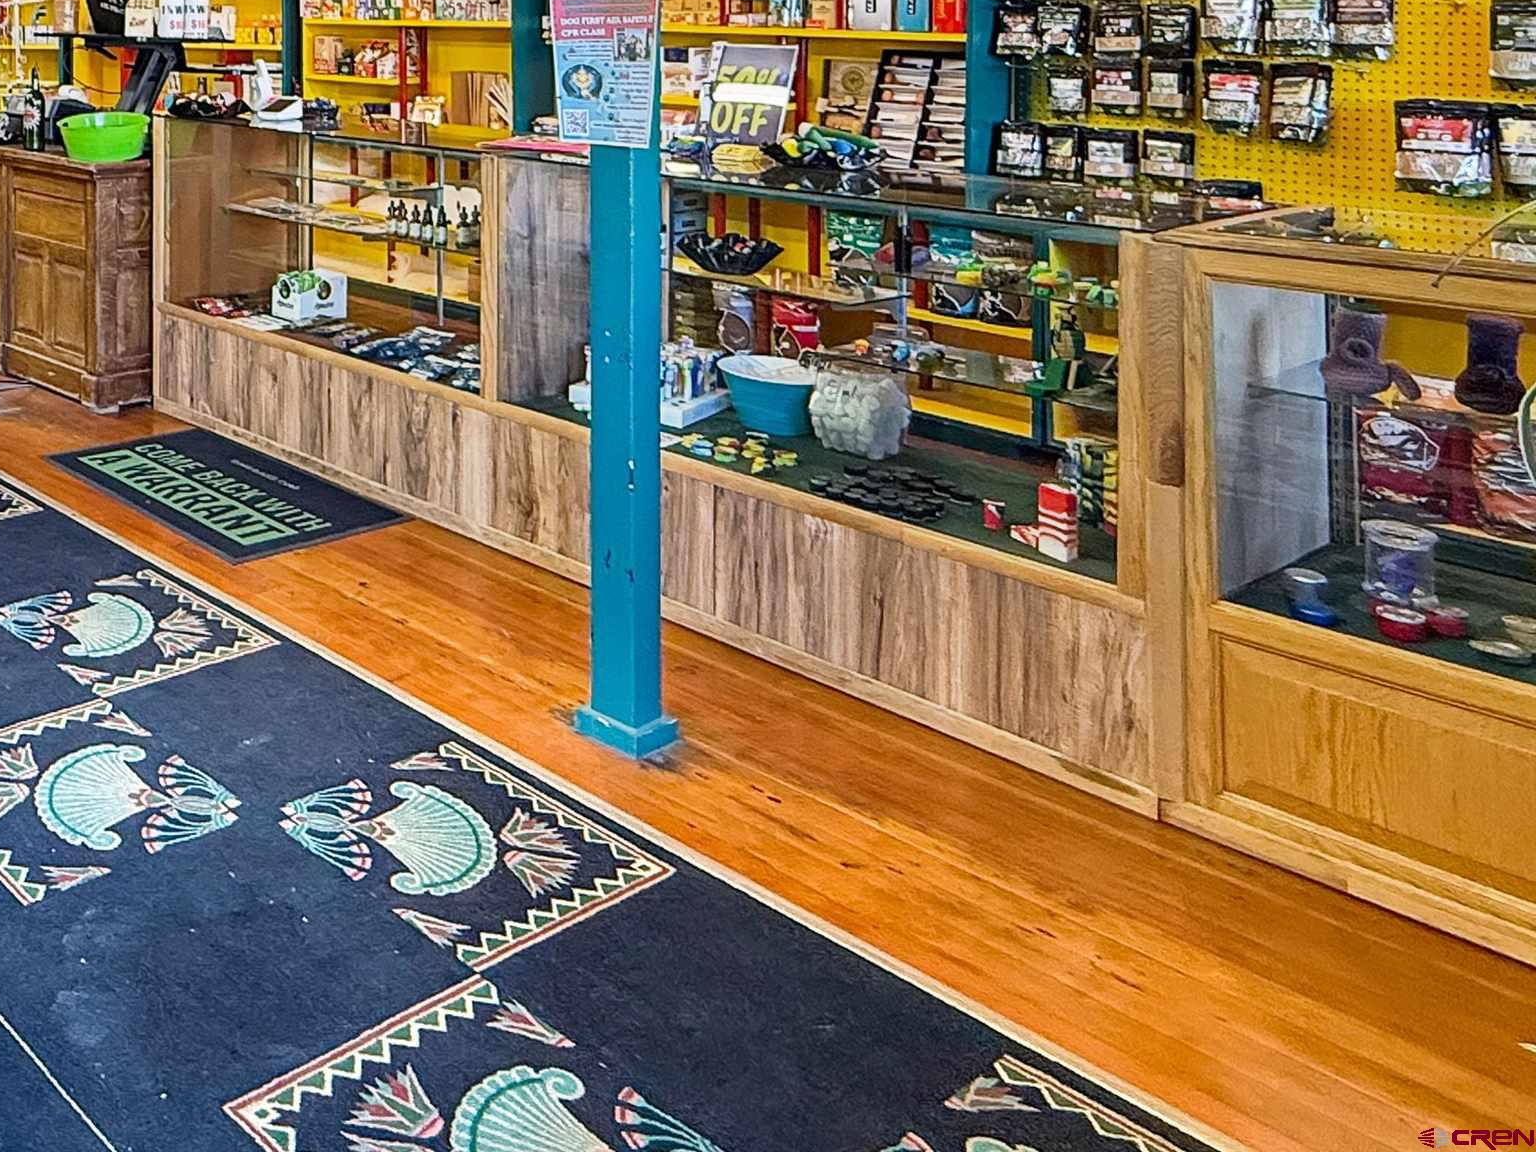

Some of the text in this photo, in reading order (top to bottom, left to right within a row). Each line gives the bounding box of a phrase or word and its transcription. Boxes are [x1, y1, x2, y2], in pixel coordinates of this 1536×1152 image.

[560, 17, 580, 25] DOG
[581, 16, 605, 25] FIRST
[560, 28, 606, 37] CPR CLASS
[711, 101, 771, 136] OFF
[88, 454, 132, 468] A
[115, 462, 285, 541] WARRANT
[135, 443, 207, 474] COME
[192, 470, 266, 501] BACK
[254, 497, 332, 532] WITH
